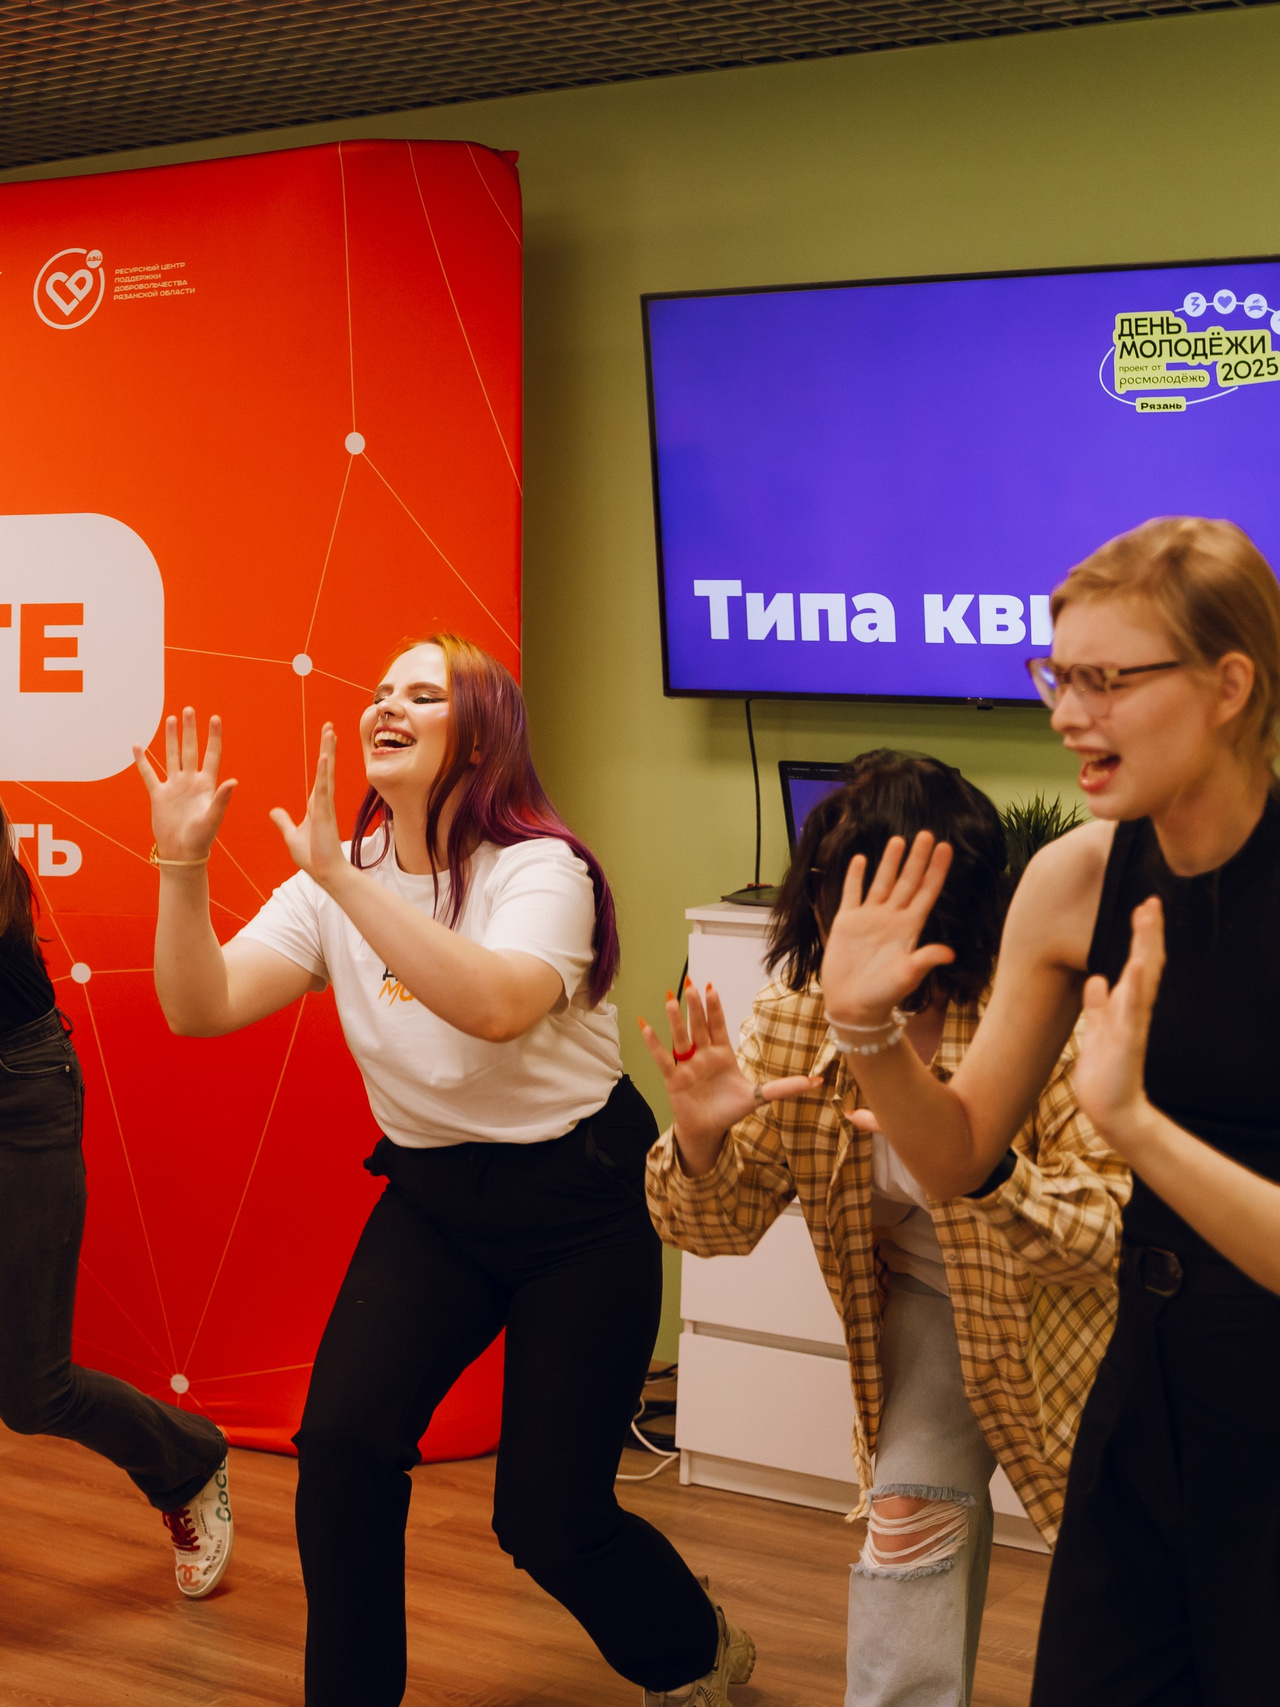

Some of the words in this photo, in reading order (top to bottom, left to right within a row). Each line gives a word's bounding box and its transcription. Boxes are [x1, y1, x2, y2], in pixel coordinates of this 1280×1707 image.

[114, 263, 159, 275] РЕСУРСНЫЙ
[160, 262, 186, 271] ЦЕНТР
[114, 273, 161, 283] ПОДДЕРЖКИ
[114, 279, 188, 292] ДОБРОВОЛЬЧЕСТВА
[113, 289, 158, 300] РЯЗАНСКОЙ
[160, 287, 196, 297] ОБЛАСТИ
[1118, 316, 1182, 340] ДЕНЬ
[1119, 331, 1267, 361] МОЛОДЁЖИ
[1118, 364, 1149, 373] проект
[1151, 364, 1162, 372] от
[1221, 357, 1280, 382] 2025
[1119, 373, 1206, 389] росмолодёжь
[1140, 402, 1183, 411] Рязань
[693, 579, 897, 643] Типа
